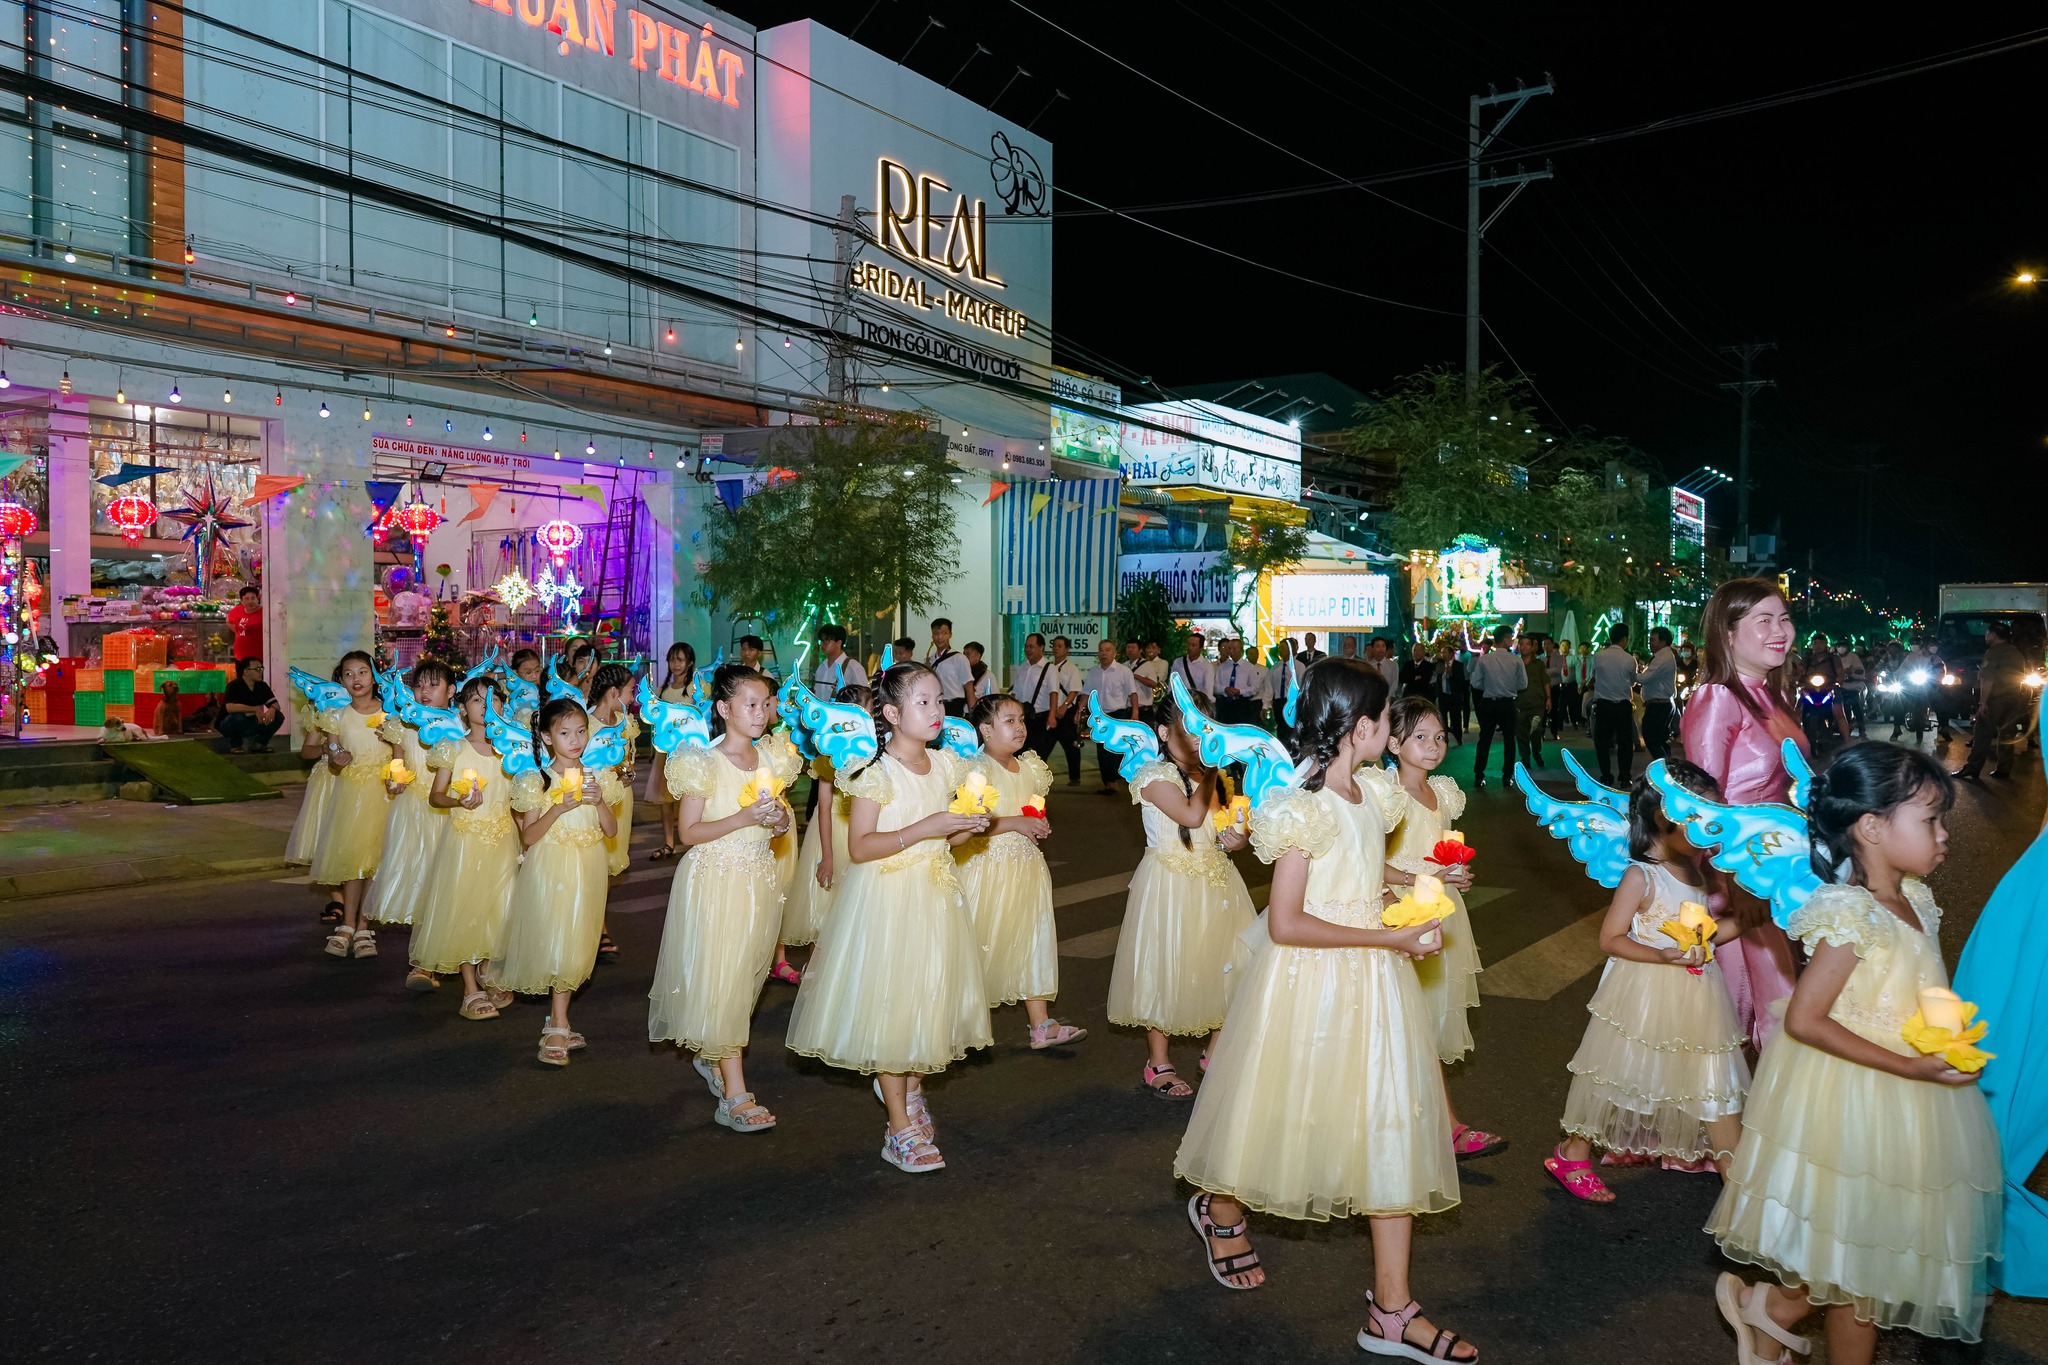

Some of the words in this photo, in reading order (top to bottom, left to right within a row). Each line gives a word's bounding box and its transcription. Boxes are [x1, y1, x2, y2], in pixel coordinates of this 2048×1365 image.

[628, 9, 745, 109] PHÁT
[878, 157, 1008, 288] REAL
[850, 261, 933, 311] BRIDAL
[945, 289, 1028, 338] MAKEUP
[904, 331, 930, 356] GÓI
[1132, 454, 1158, 479] HẢI
[1190, 557, 1206, 604] SỐ
[1209, 572, 1229, 604] 155
[1040, 619, 1065, 636] QUẦY
[1067, 618, 1099, 635] THUỐC
